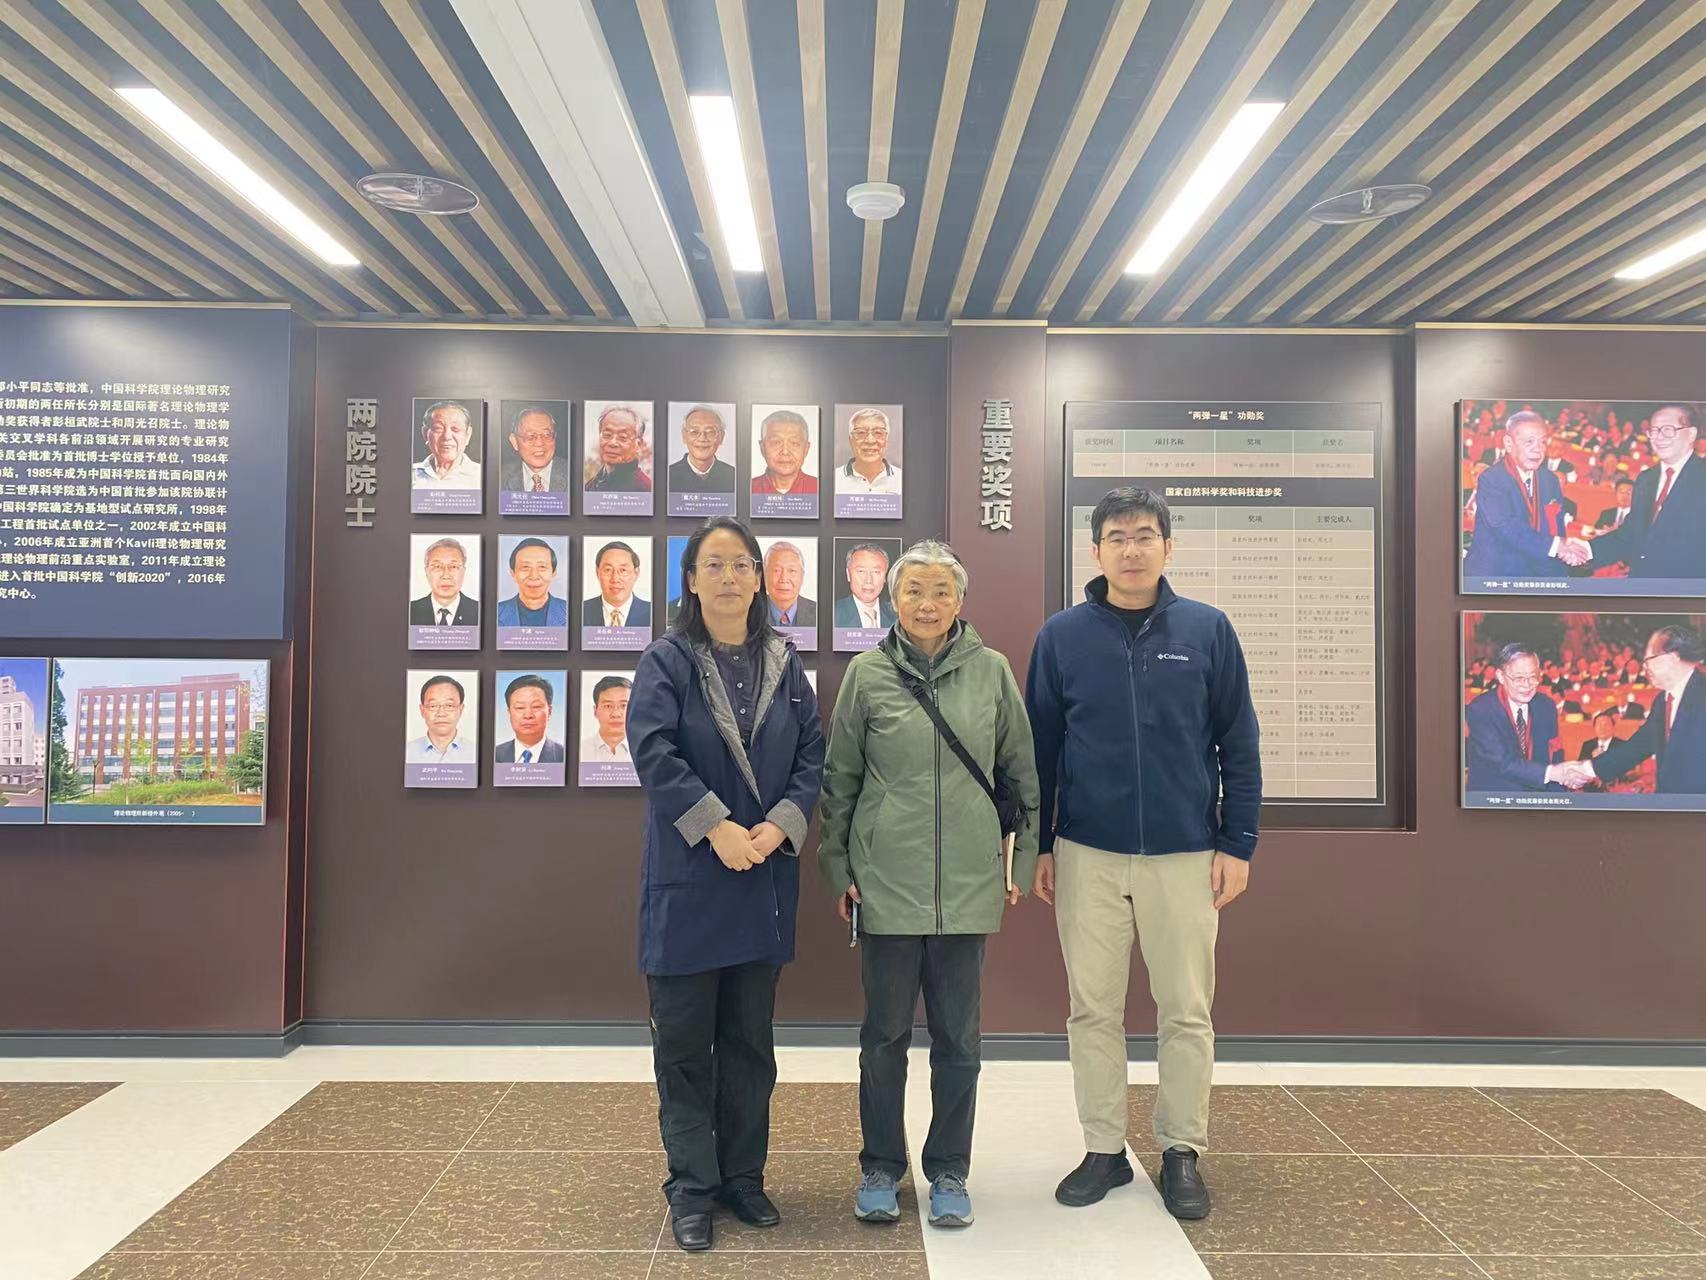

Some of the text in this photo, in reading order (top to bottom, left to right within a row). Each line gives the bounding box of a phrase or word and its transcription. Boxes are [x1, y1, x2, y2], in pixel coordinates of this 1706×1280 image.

[1154, 438, 1184, 446] 项目名称
[345, 398, 379, 527] 两院院士
[980, 399, 1014, 531] 重要奖项
[0, 467, 228, 481] 站，1985年成为中国科学院首批面向国内外
[1165, 487, 1283, 498] 国家自然科学奖和科技进步奖
[0, 501, 227, 515] 国科学院确定为基地型试点研究所，1998年
[1315, 514, 1352, 523] 主要完成人
[0, 536, 226, 550] ，2006年成立亚洲首个Kavli理论物理研究
[1163, 653, 1189, 661] Columbia
